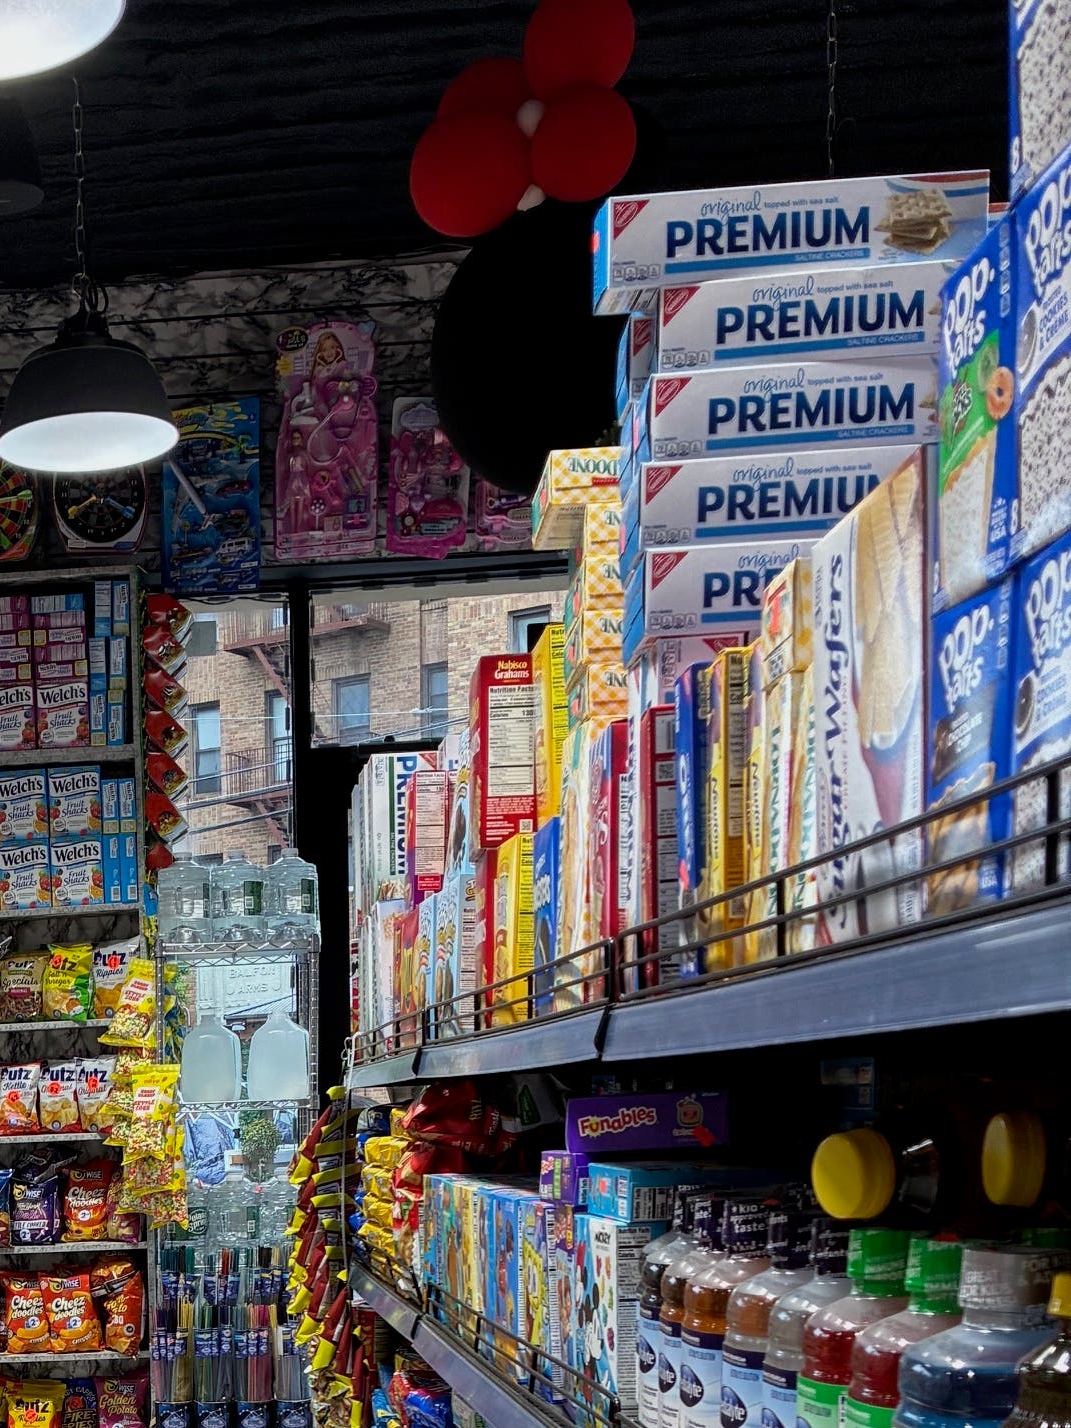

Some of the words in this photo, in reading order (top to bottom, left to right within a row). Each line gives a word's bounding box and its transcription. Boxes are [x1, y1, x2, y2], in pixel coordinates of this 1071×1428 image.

[701, 191, 761, 228] original
[667, 206, 870, 258] PREMIUM
[753, 276, 814, 312] original
[716, 289, 924, 345] PREMIUM
[744, 368, 805, 402] original
[708, 383, 915, 435] PREMIUM
[733, 457, 794, 490] original
[825, 553, 850, 752] Wafers
[498, 660, 527, 671] Nabisco
[495, 669, 529, 680] Grahams
[51, 774, 98, 794] Welch's
[1, 847, 47, 867] Welch's
[579, 1107, 656, 1136] Funables
[68, 1187, 104, 1198] Cheez
[63, 1280, 80, 1288] WISE
[11, 1296, 43, 1309] Cheez
[52, 1297, 85, 1310] Cheez
[12, 1306, 42, 1318] doodles
[55, 1307, 85, 1319] doodles
[118, 1384, 134, 1394] WISE
[99, 1395, 137, 1407] Golden
[108, 1406, 137, 1415] Potato
